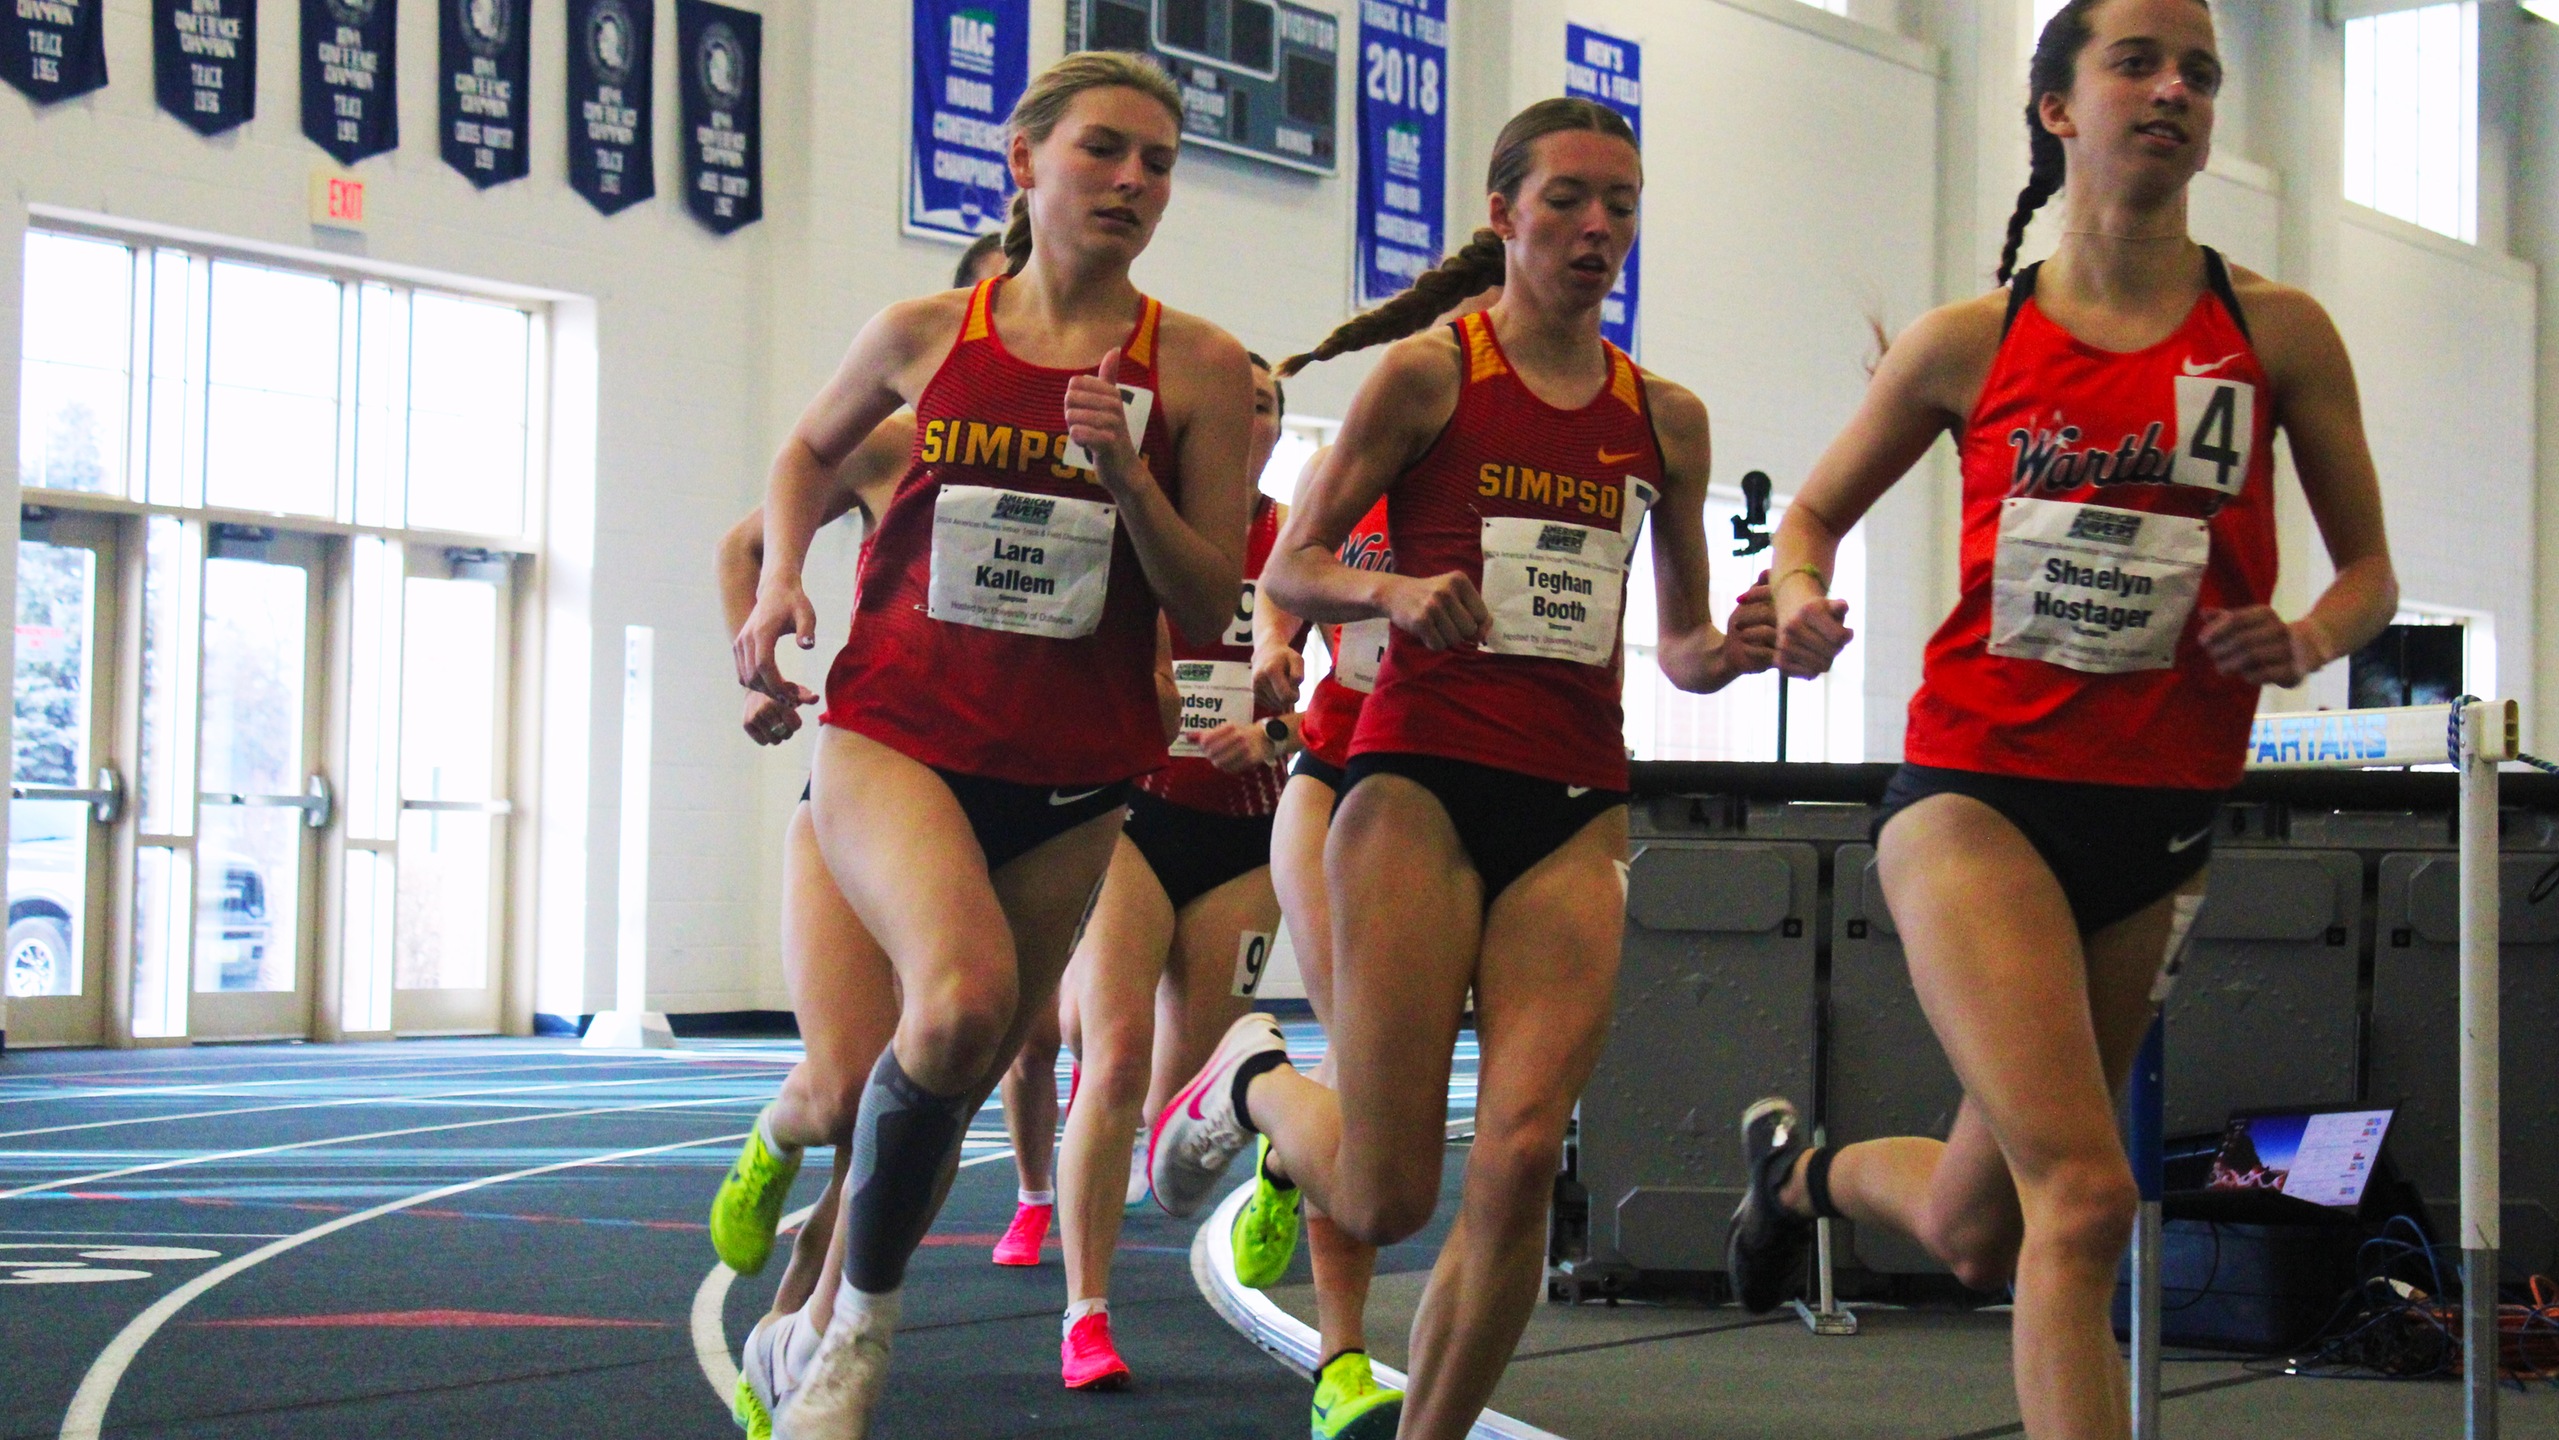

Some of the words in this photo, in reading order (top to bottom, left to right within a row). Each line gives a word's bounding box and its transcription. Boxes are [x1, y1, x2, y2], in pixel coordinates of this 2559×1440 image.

[1366, 41, 1440, 117] 2018
[328, 177, 364, 222] EXIT
[2190, 385, 2240, 485] 4
[2008, 421, 2178, 497] Wartb
[994, 538, 1044, 565] Lara
[975, 565, 1055, 595] Kallem
[1526, 566, 1592, 595] Teghan
[2045, 557, 2153, 598] Shaelyn
[1235, 582, 1256, 642] 9
[1533, 596, 1586, 623] Booth
[2034, 591, 2153, 631] Hostager
[1242, 936, 1264, 995] 9
